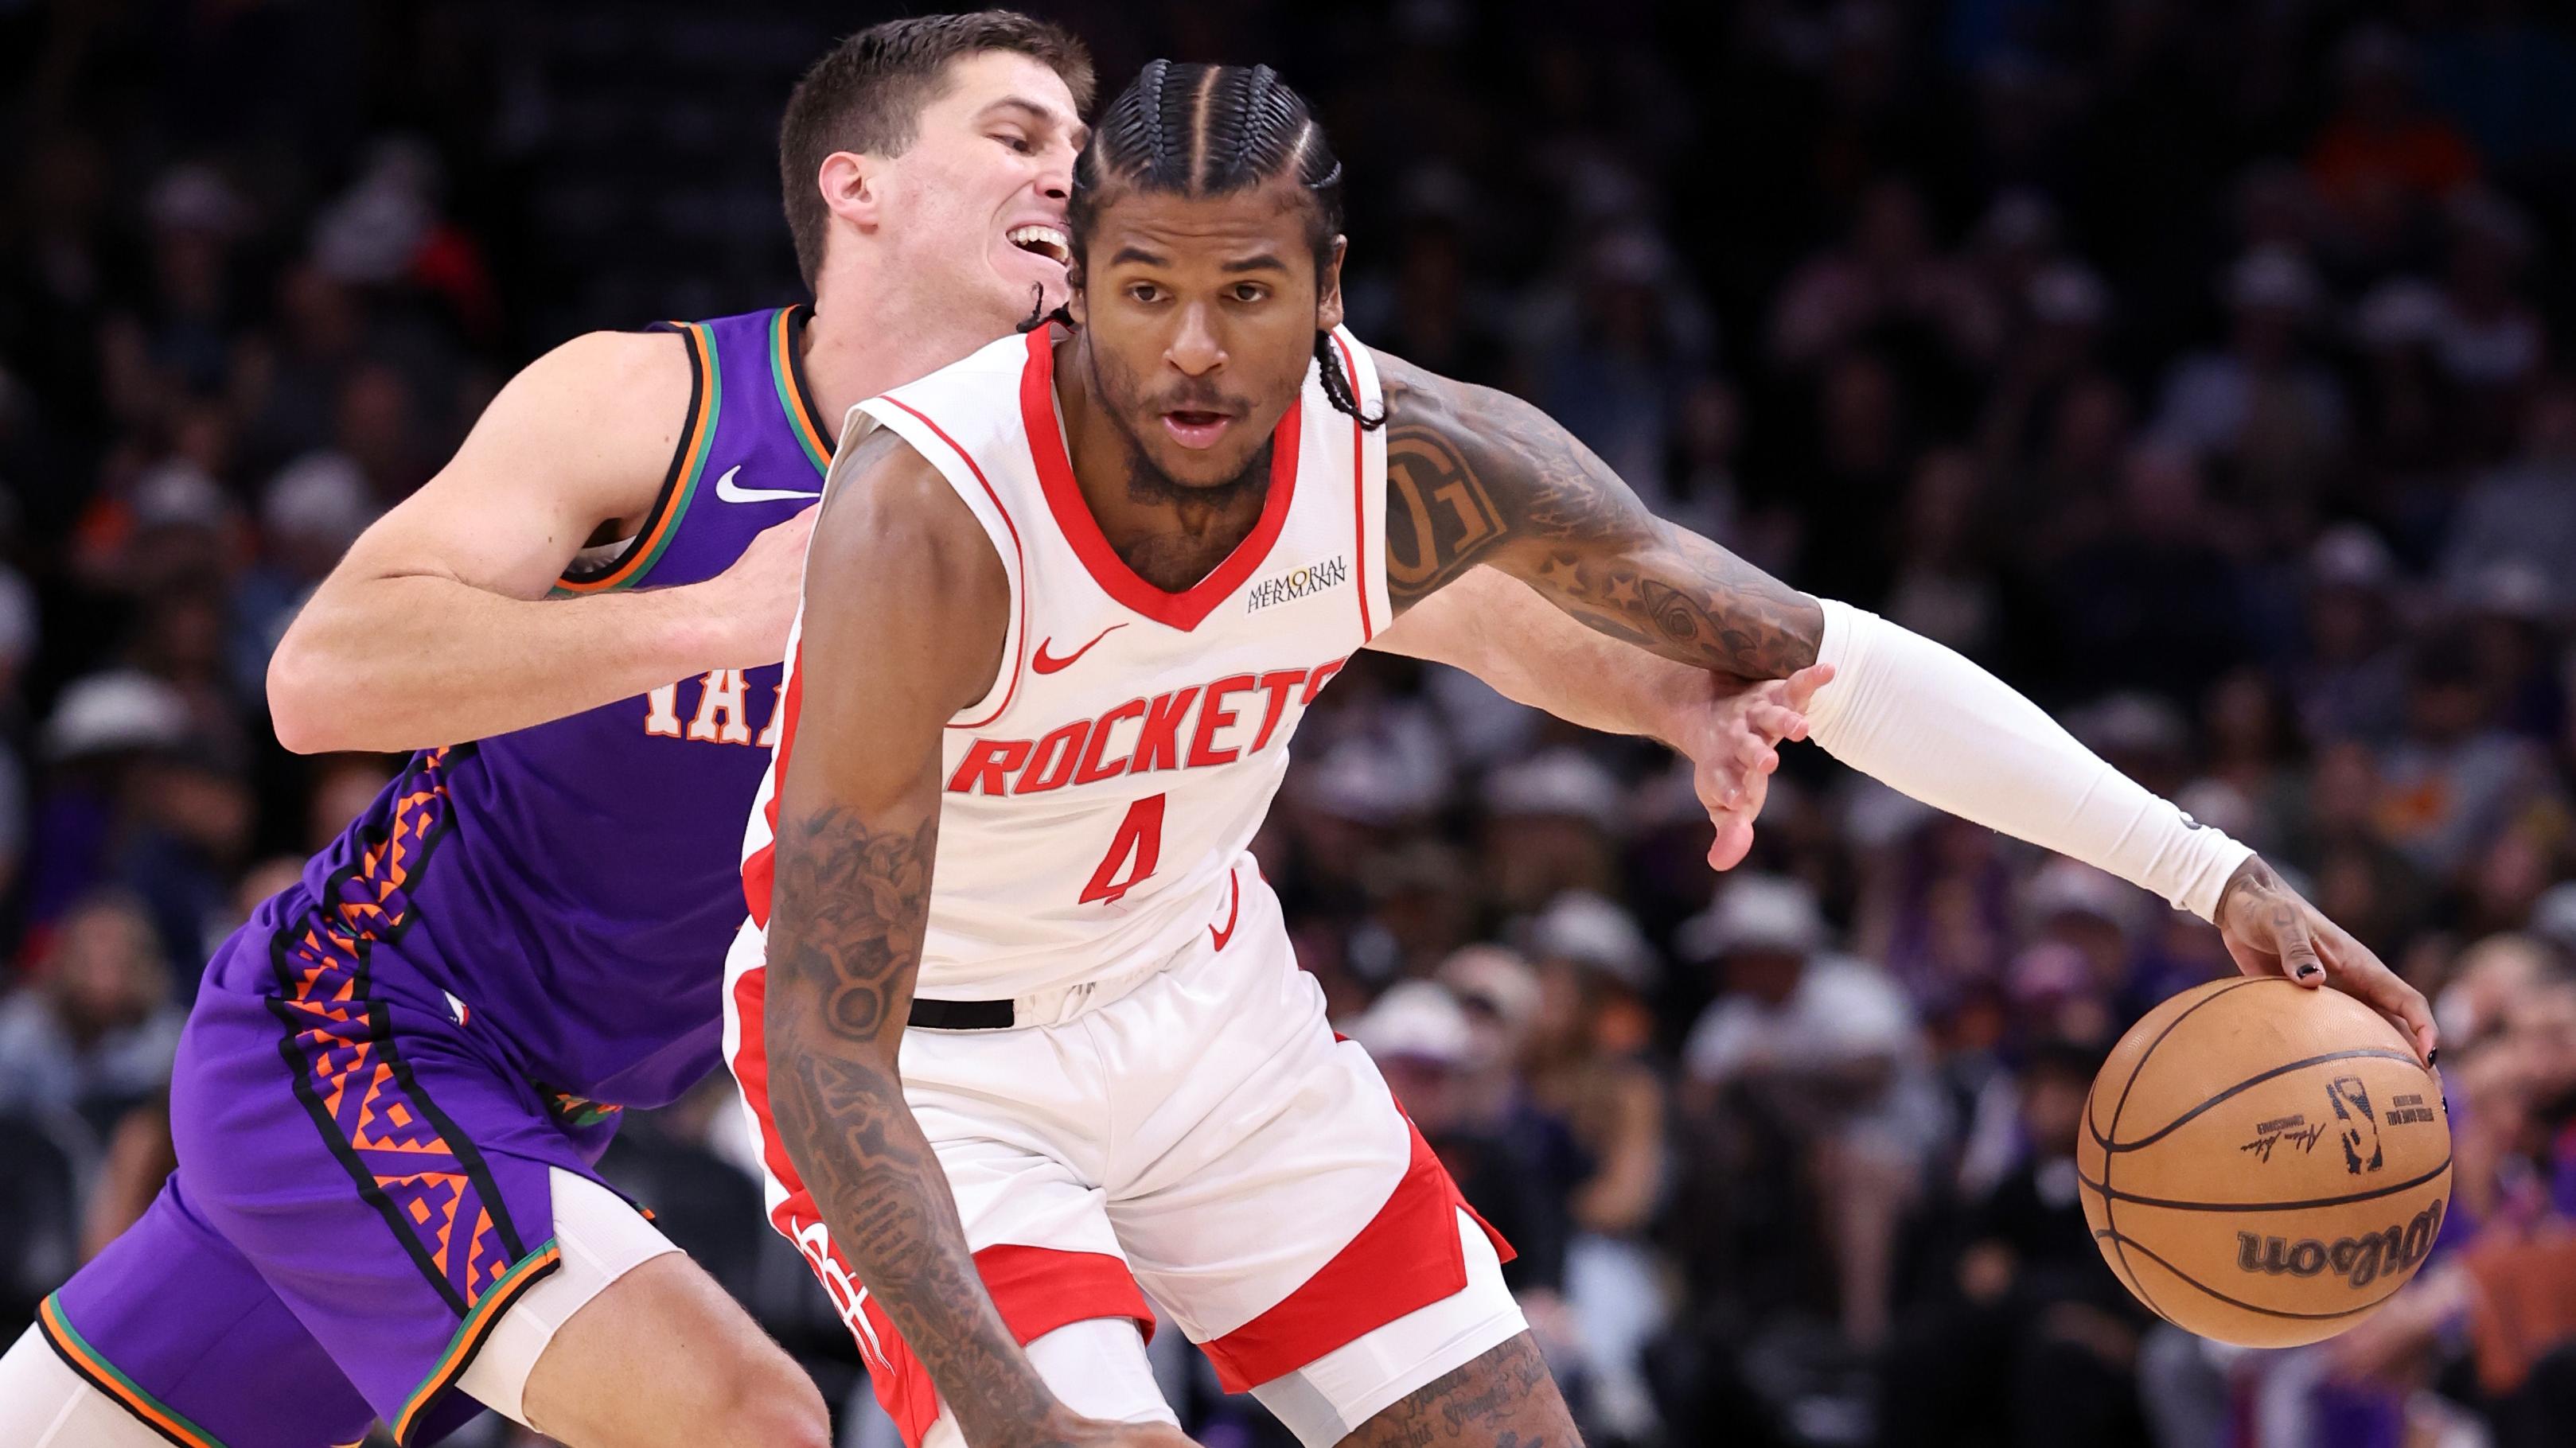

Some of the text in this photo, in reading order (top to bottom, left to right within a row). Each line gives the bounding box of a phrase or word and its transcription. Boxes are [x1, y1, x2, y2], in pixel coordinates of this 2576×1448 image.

[1248, 568, 1345, 613] HERMANN
[1249, 555, 1346, 599] MEMORIAL
[1078, 792, 1166, 906] 4
[2237, 1198, 2442, 1289] Wilson
